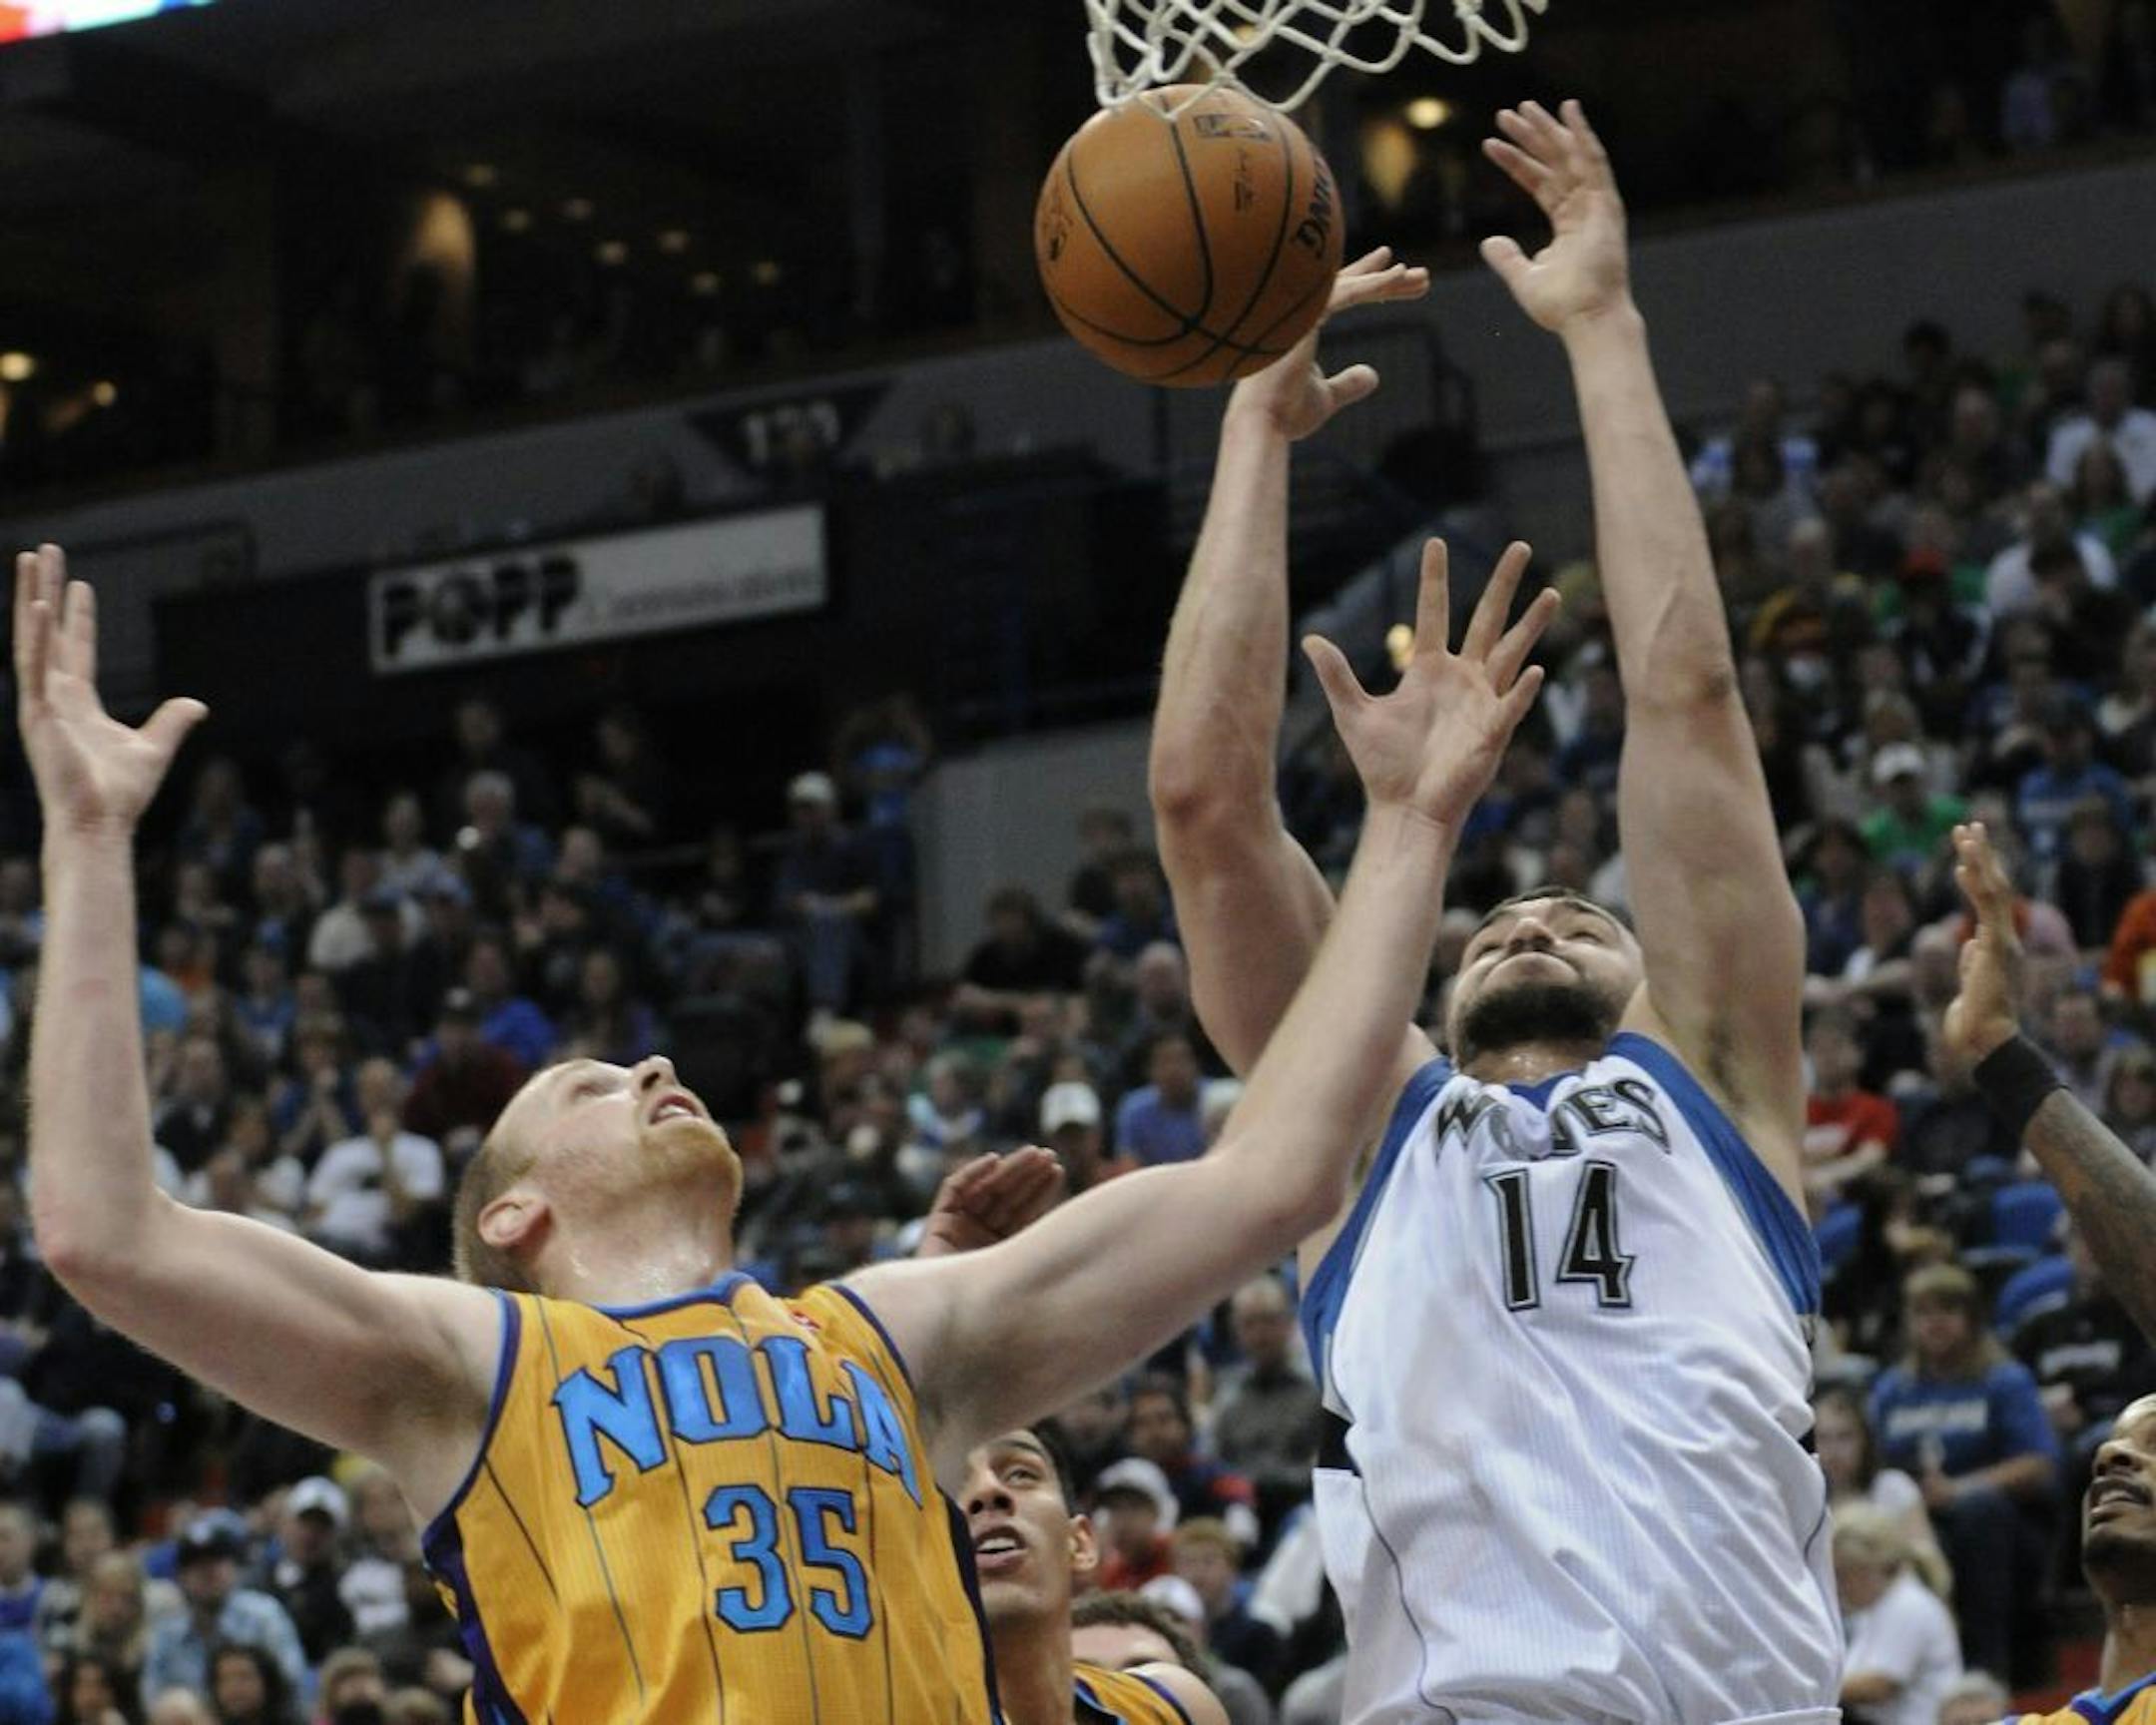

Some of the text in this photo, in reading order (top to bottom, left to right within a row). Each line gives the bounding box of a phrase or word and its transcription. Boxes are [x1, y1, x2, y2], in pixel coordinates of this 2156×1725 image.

[384, 555, 577, 655] POPP
[1484, 1160, 1636, 1313] 14
[551, 1335, 924, 1510] NOLA
[703, 1484, 874, 1641] 35
